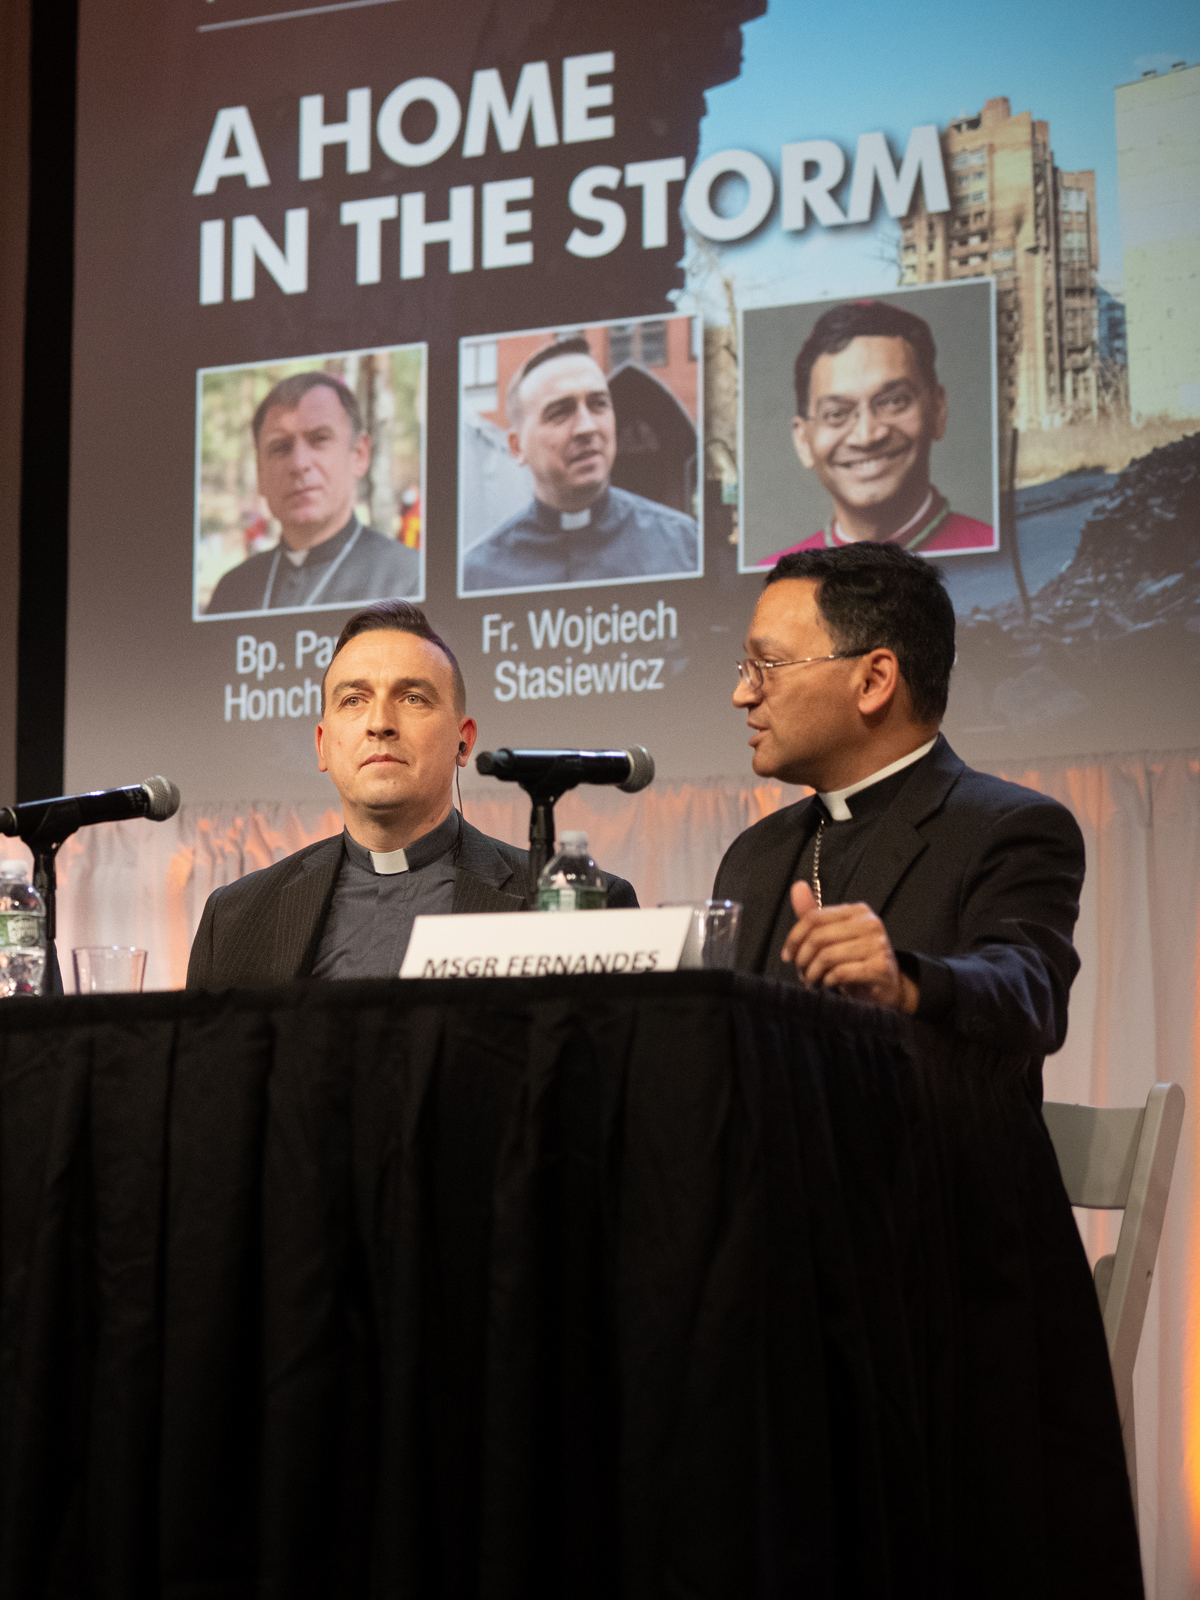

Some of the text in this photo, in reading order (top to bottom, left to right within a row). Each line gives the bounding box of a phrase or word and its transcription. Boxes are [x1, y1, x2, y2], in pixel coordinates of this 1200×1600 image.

[193, 52, 615, 196] A HOME
[200, 125, 951, 305] IN THE STORM
[482, 600, 678, 655] Fr. Wojciech
[236, 630, 338, 681] Bp. Pa
[494, 652, 665, 702] Stasiewicz
[421, 950, 661, 979] MSGR FERNANDES
